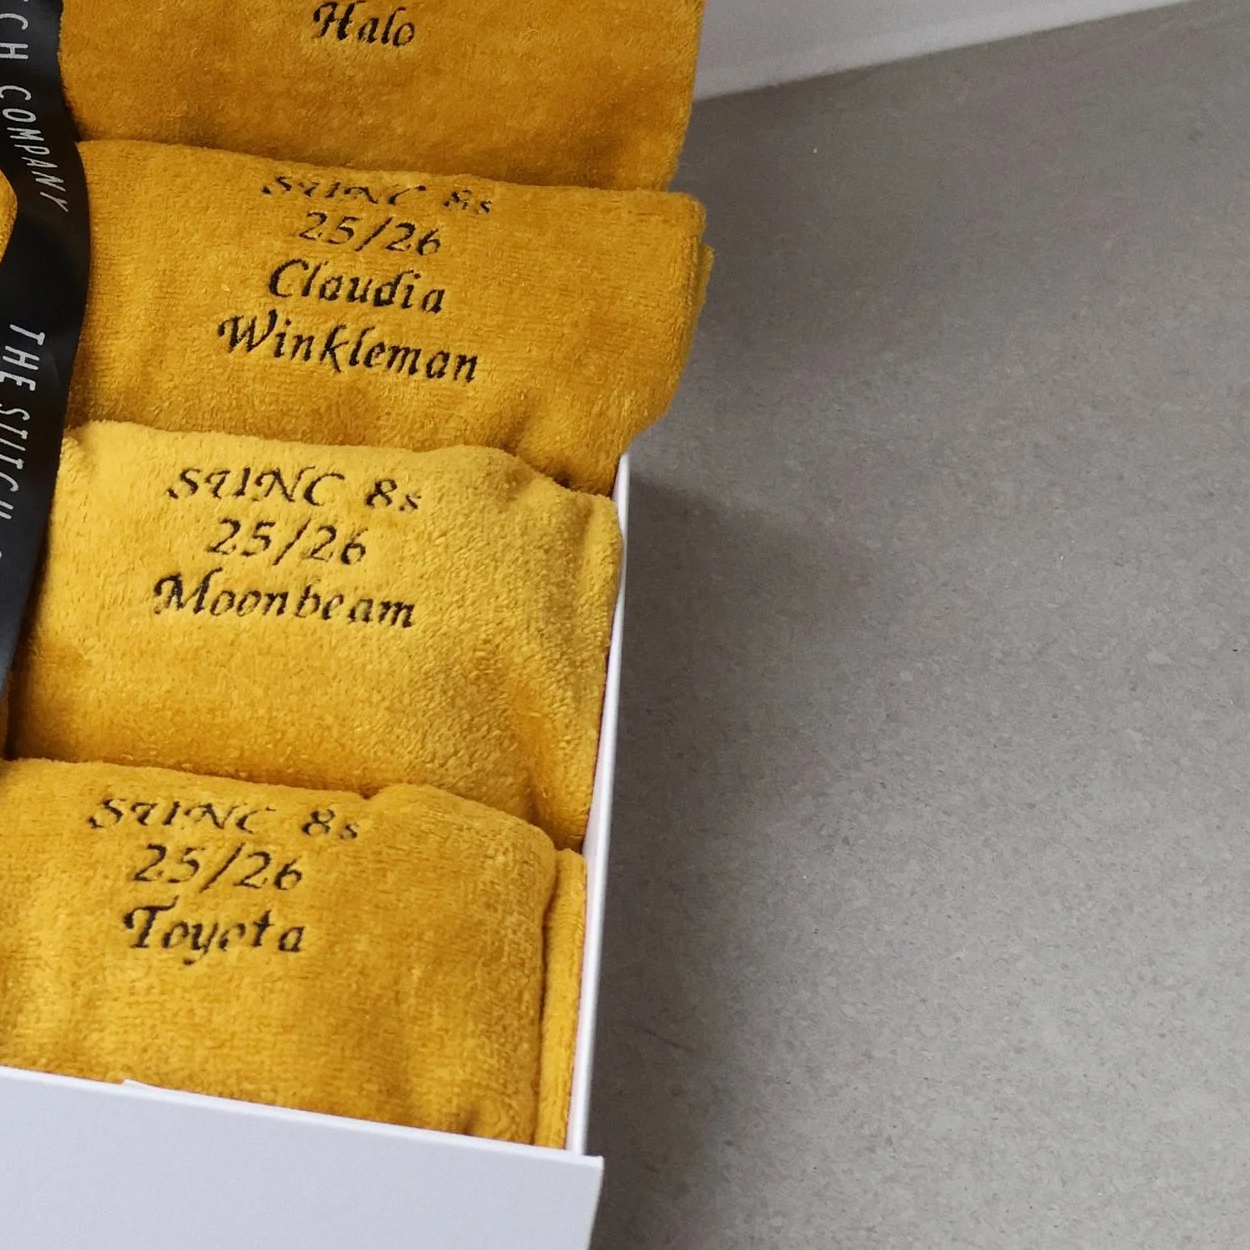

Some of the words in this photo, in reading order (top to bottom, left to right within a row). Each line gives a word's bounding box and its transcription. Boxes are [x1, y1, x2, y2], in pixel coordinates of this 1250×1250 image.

[313, 0, 415, 48] Halo
[298, 210, 442, 257] 25/26
[267, 257, 446, 315] Claudia
[217, 309, 479, 385] Winkleman
[167, 465, 346, 507] SUNC
[365, 478, 423, 512] 8s
[206, 517, 369, 567] 25/26
[152, 567, 416, 629] Moonbeam
[301, 808, 359, 840] 8s
[130, 841, 304, 894] 25/26
